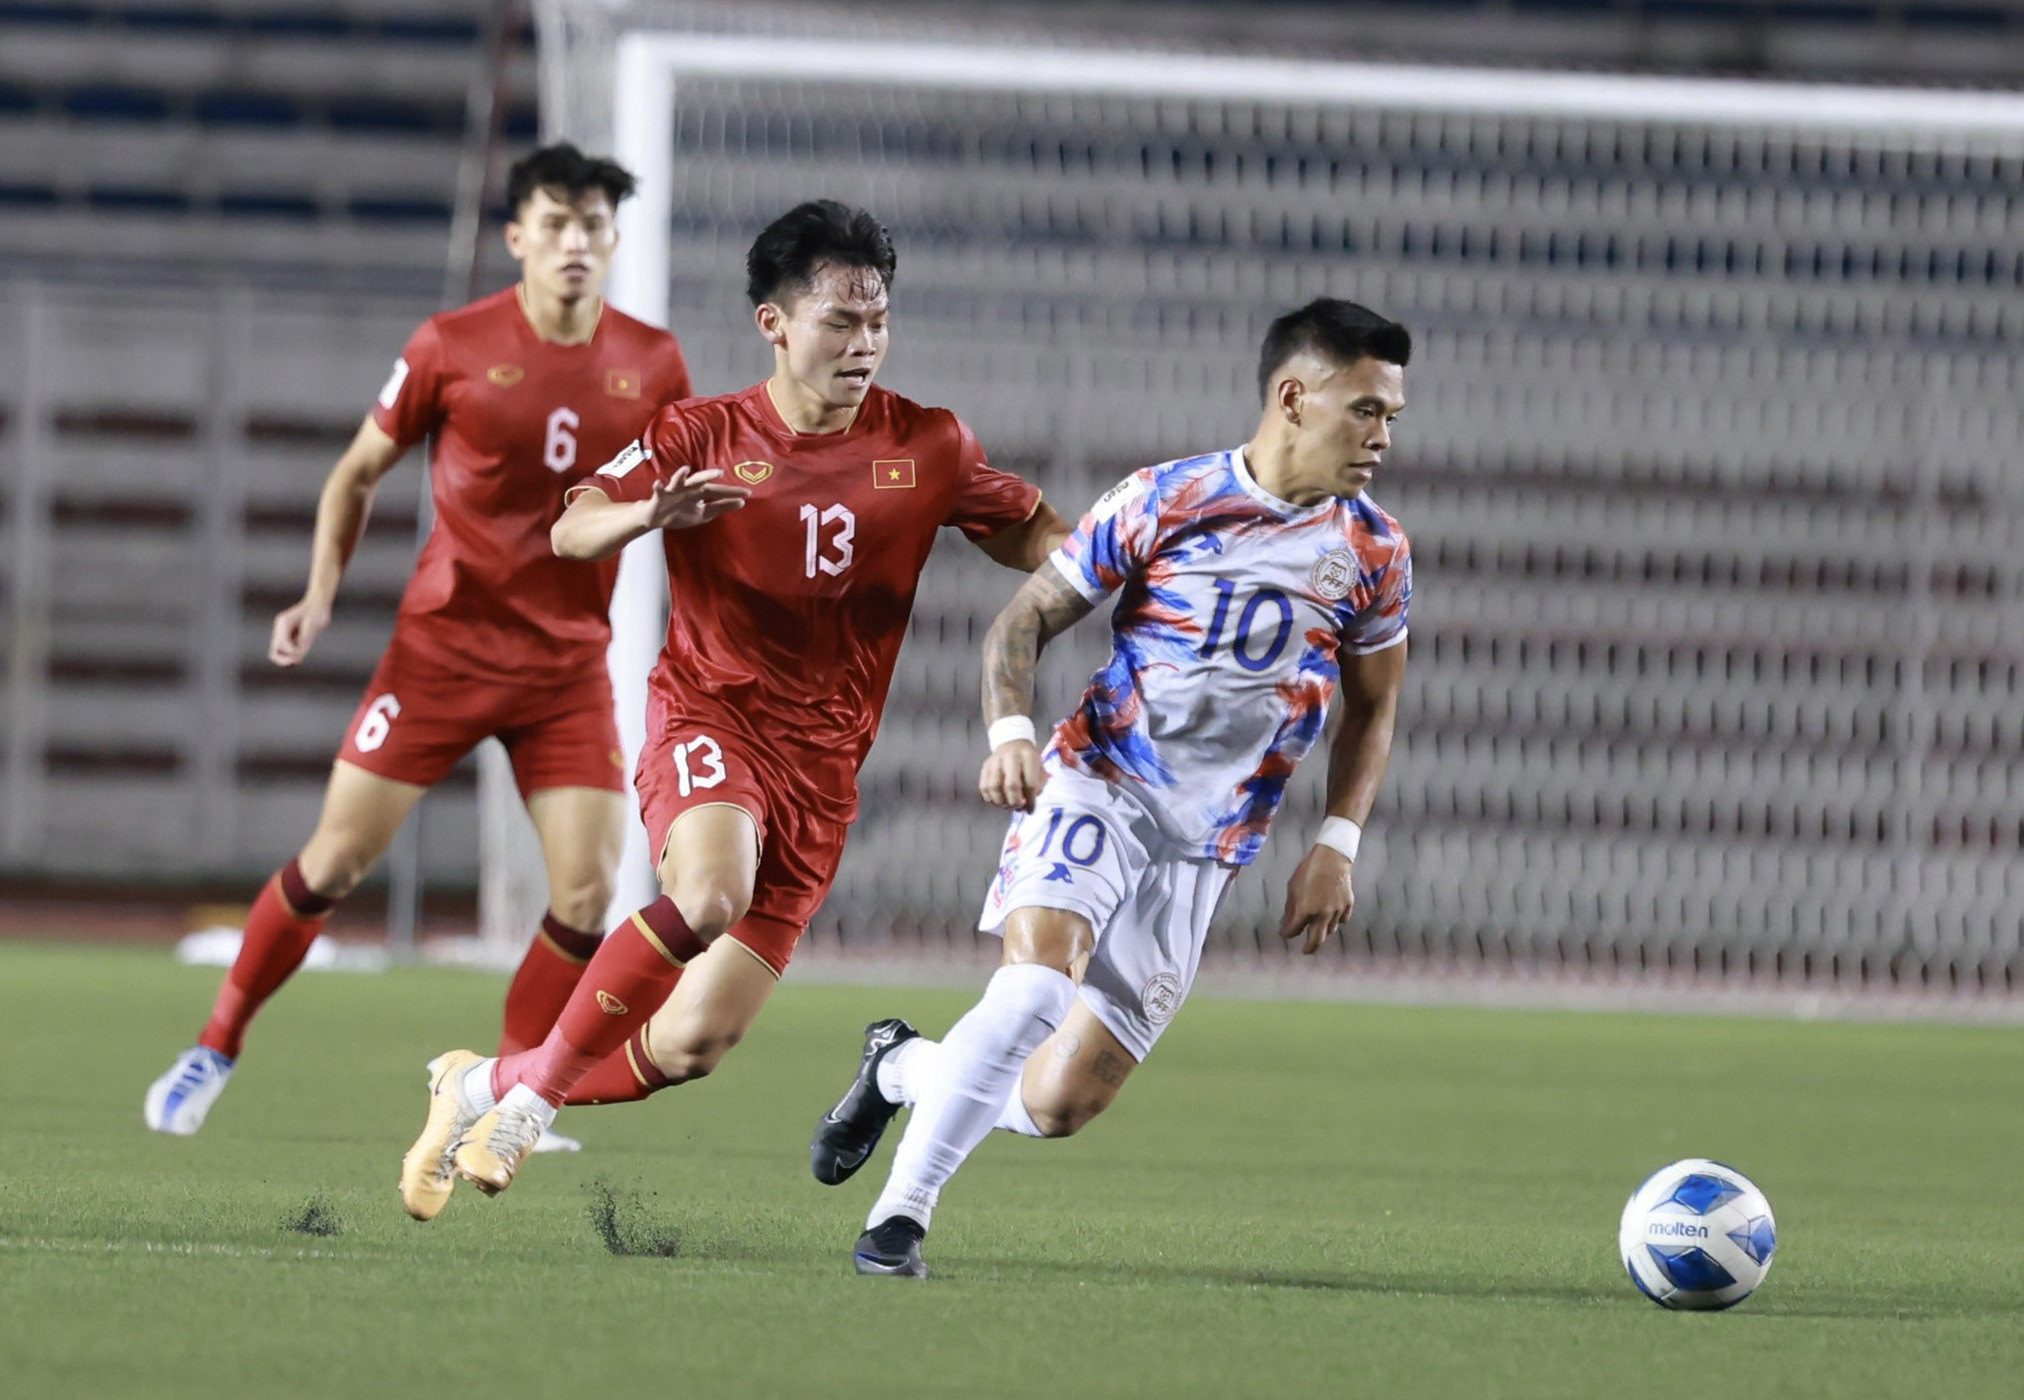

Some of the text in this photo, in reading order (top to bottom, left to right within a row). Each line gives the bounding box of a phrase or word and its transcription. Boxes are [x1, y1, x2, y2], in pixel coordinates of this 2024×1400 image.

[543, 407, 580, 473] 6
[799, 503, 856, 579] 13
[1321, 574, 1346, 588] PFF
[1199, 576, 1293, 672] 10
[354, 692, 402, 754] 6
[672, 734, 727, 798] 13
[1037, 807, 1106, 867] 10
[1650, 1222, 1709, 1239] molten
